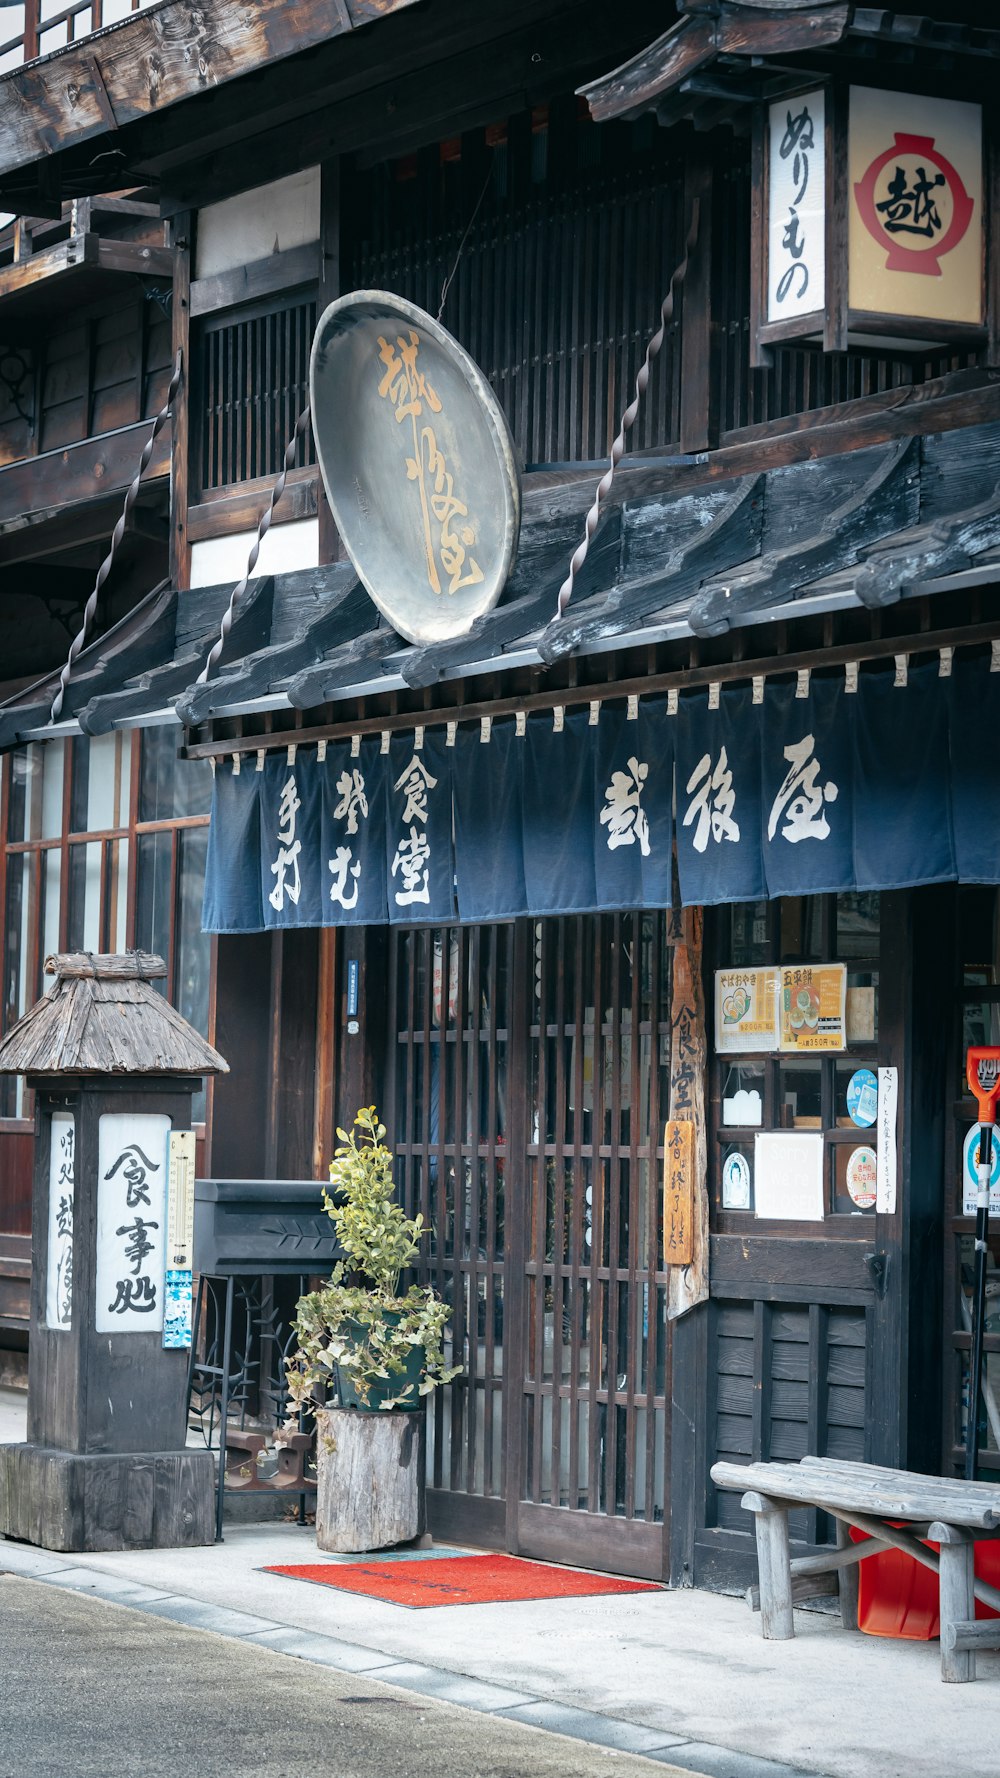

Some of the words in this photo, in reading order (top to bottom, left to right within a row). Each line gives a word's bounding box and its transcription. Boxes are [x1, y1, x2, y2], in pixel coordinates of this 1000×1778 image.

[776, 106, 815, 303] ぬりもの
[876, 166, 946, 239] 越
[391, 754, 439, 906] 食堂
[720, 973, 757, 988] そばおやき
[783, 968, 812, 987] 五平餅
[672, 1004, 697, 1110] 食堂
[770, 1143, 809, 1163] Sorry
[104, 1144, 160, 1314] 食事処
